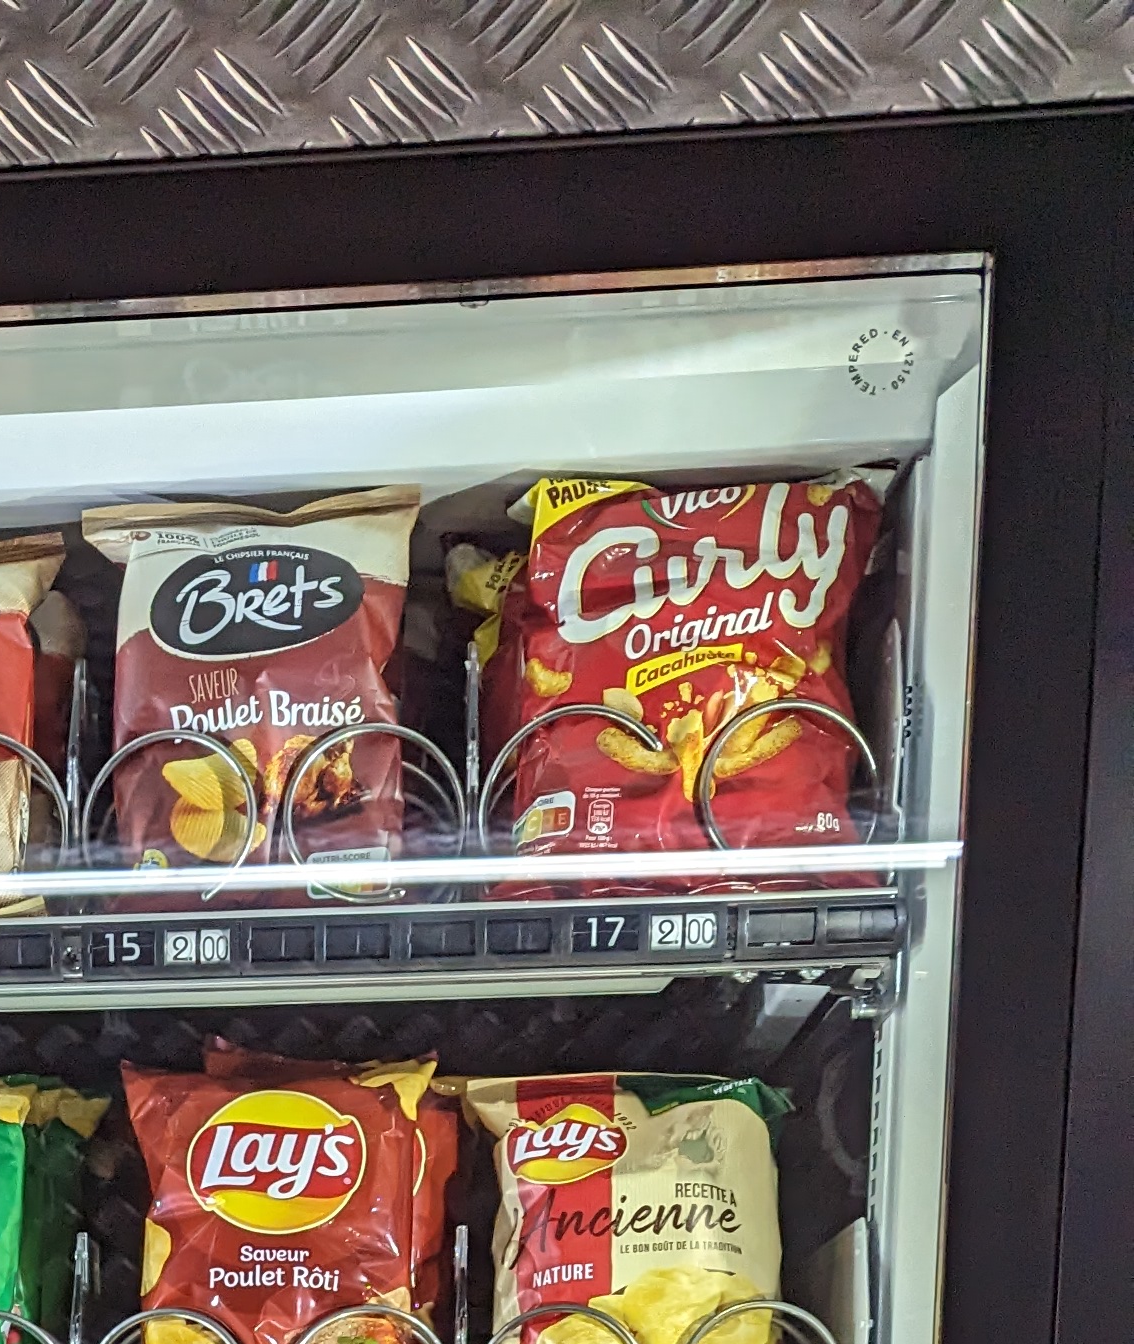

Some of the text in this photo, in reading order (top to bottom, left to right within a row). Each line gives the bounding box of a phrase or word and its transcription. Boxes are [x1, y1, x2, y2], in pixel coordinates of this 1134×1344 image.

[848, 328, 914, 396] TEMPERED EN 12150
[266, 548, 310, 561] FRANÇAIS
[557, 482, 850, 645] Curly
[624, 591, 774, 661] Original
[188, 667, 240, 705] SAVEUR
[169, 690, 366, 744] Poulet Braisé
[105, 933, 141, 962] 15
[586, 917, 625, 947] 17
[514, 1120, 621, 1161] Lay's
[200, 1124, 356, 1200] Lay's
[675, 1182, 727, 1201] RECETTE
[239, 1245, 310, 1264] Saveur
[209, 1264, 341, 1292] Poulet Rôti
[532, 1263, 594, 1289] NATURE
